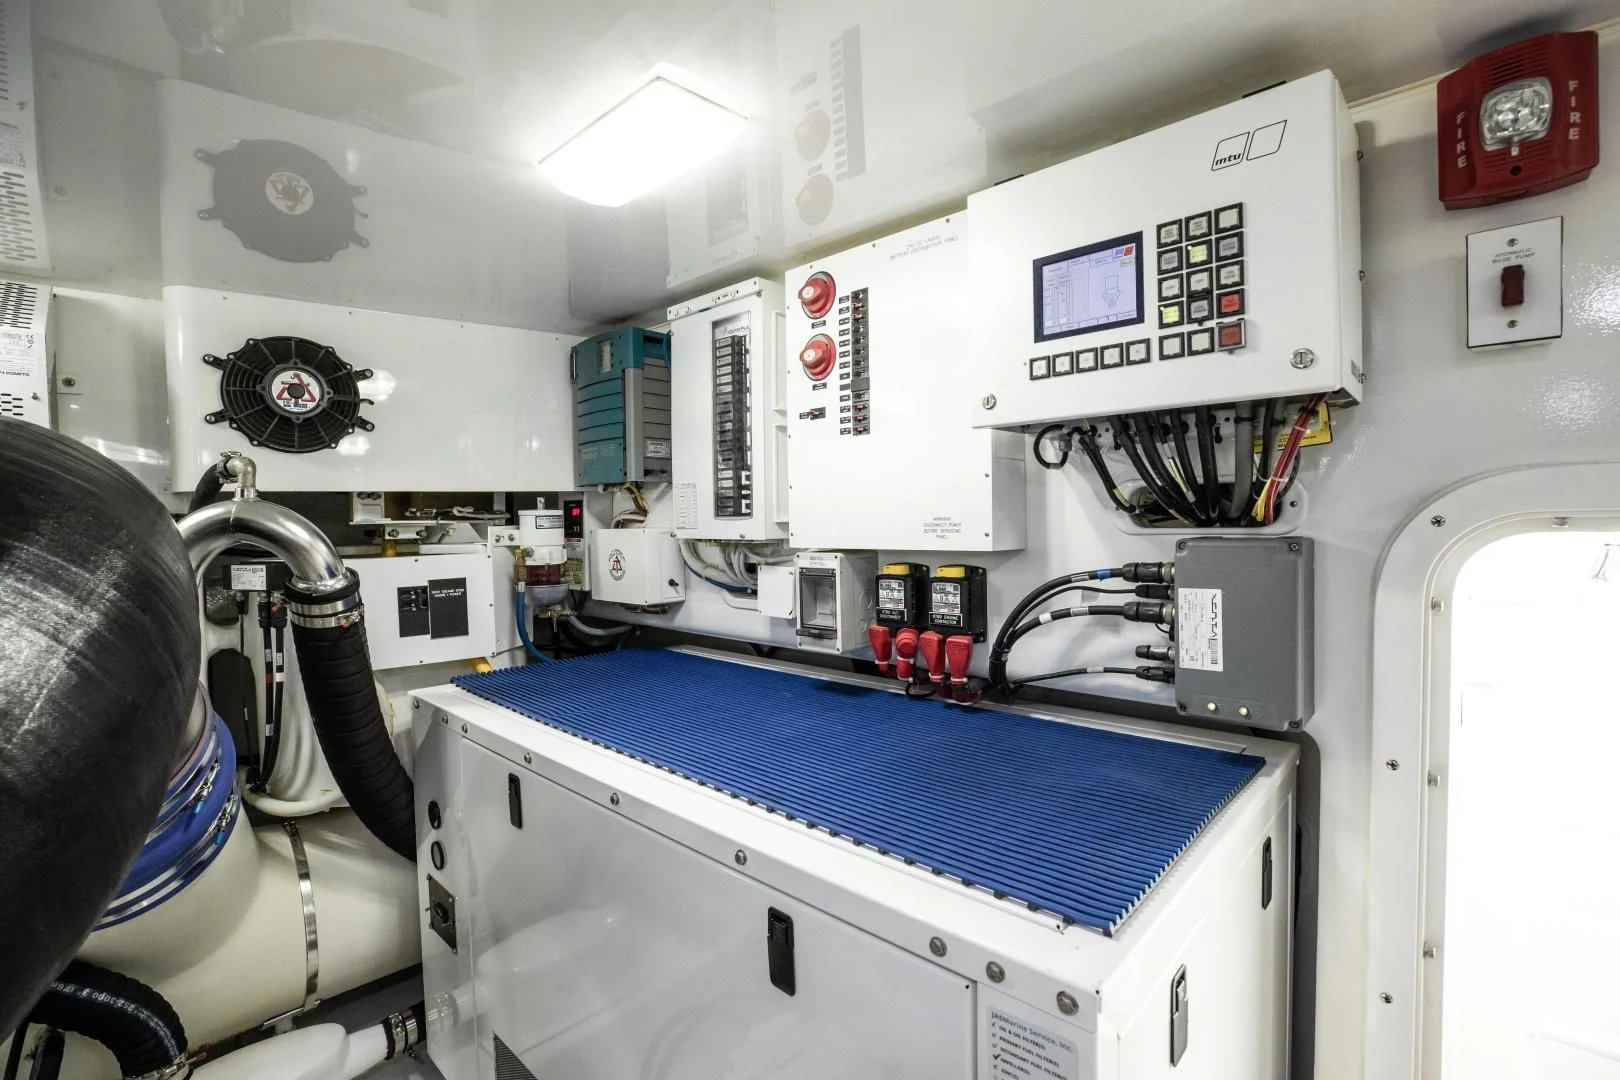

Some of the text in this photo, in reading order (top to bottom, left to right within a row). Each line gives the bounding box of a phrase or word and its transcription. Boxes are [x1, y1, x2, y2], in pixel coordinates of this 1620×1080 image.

[1568, 80, 1581, 140] FIRE
[1456, 111, 1467, 169] FIRE
[1215, 152, 1241, 166] mtu
[1515, 251, 1536, 260] PUMP
[999, 1036, 1021, 1049] PRIMARY
[1022, 1046, 1034, 1056] FUEL
[1030, 1060, 1042, 1070] FUEL
